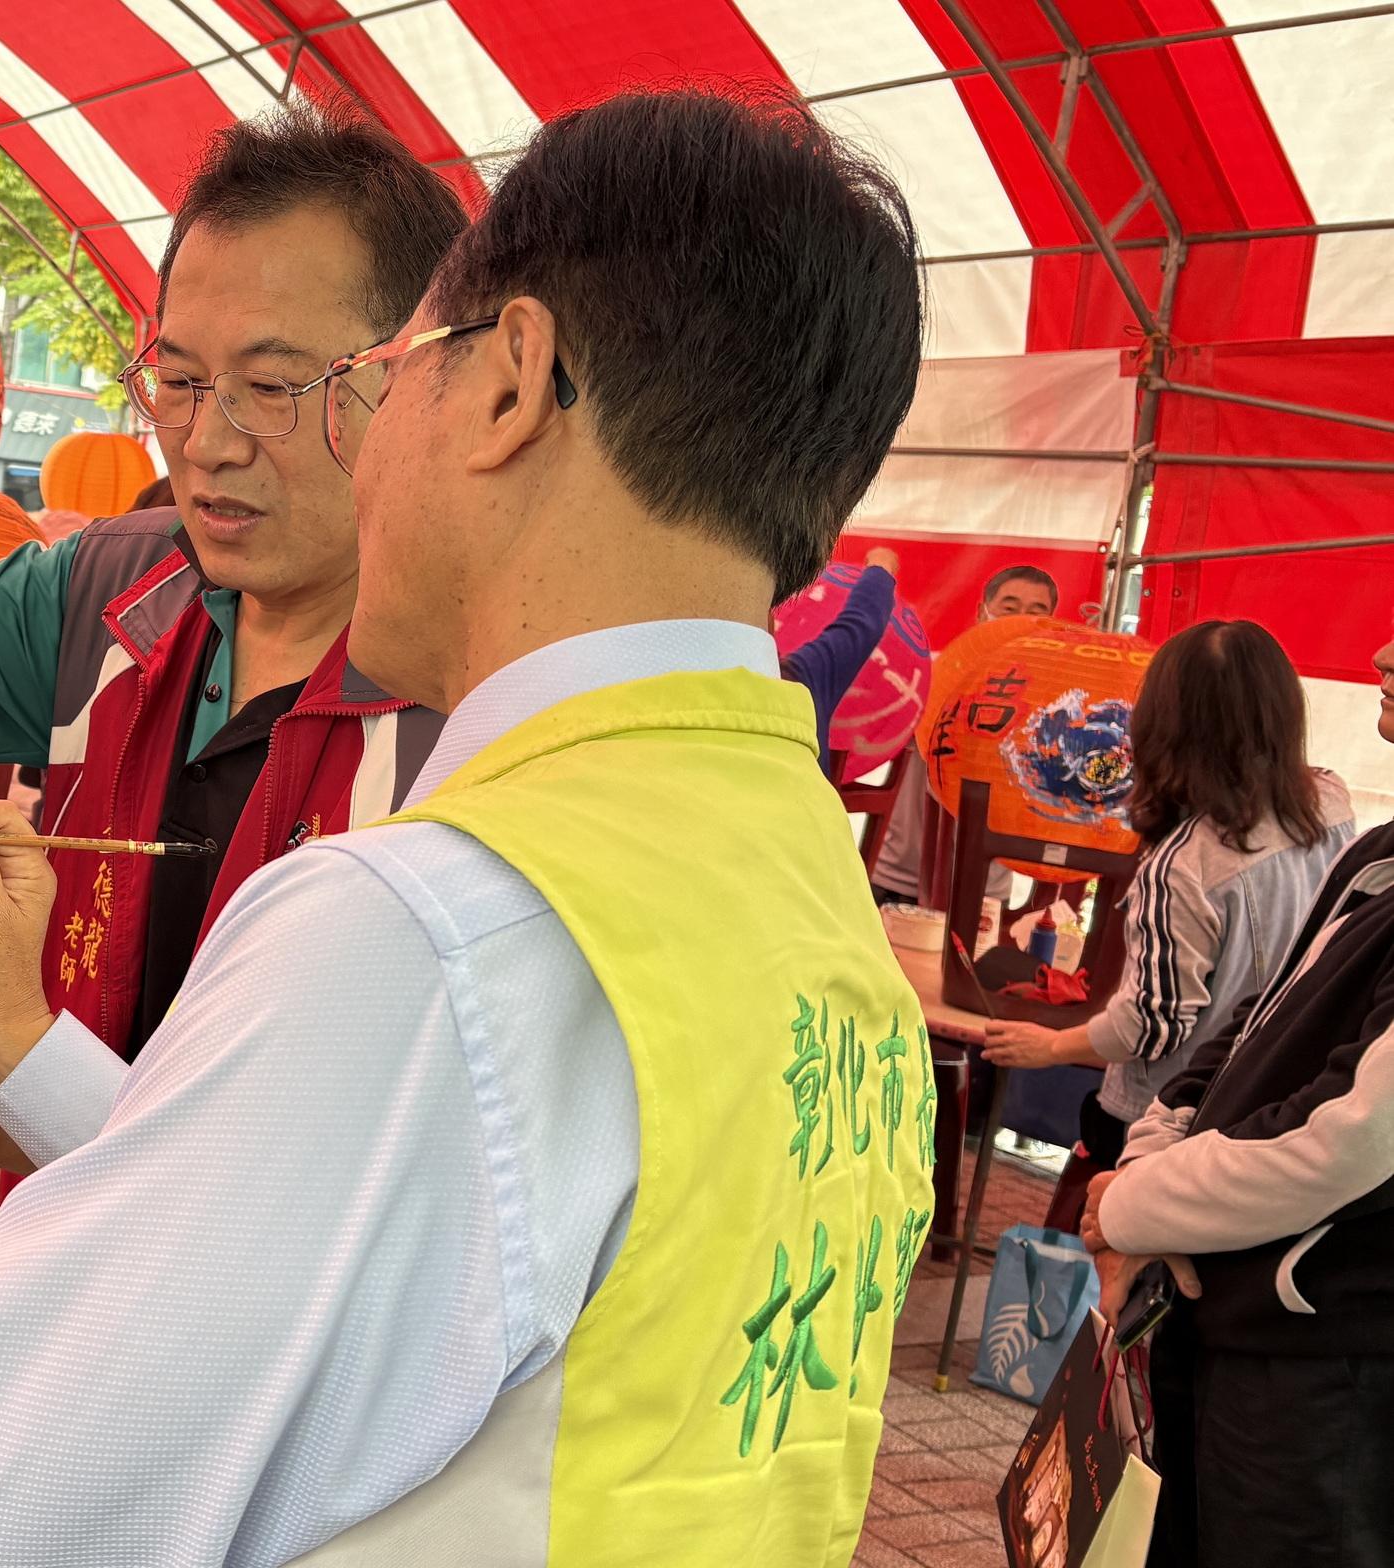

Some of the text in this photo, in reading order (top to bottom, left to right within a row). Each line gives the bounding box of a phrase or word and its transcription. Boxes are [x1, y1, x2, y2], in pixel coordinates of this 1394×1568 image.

[58, 909, 84, 994] 老師
[782, 991, 938, 1182] 彰化市長
